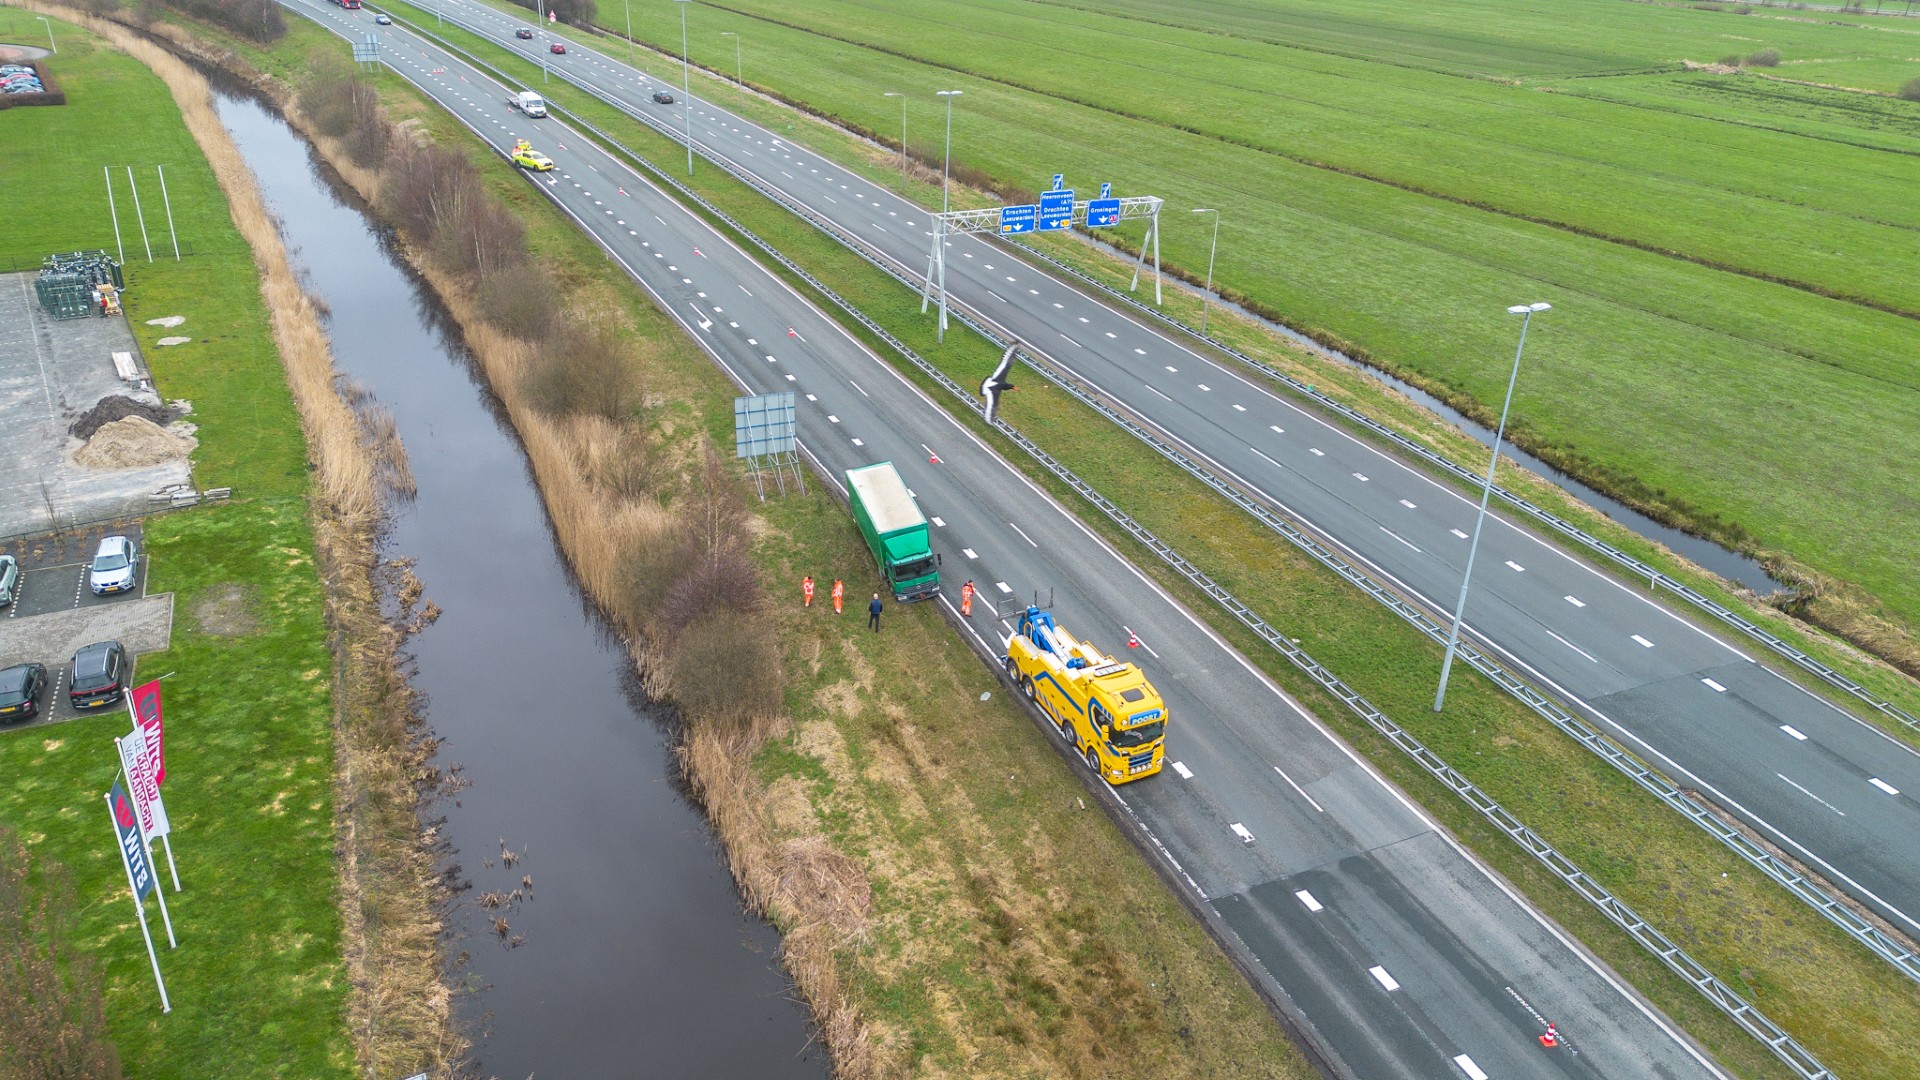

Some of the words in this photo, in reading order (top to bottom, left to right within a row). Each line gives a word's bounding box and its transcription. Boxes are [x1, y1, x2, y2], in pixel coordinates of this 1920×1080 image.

[124, 743, 136, 769] VAN
[134, 737, 145, 754] DE
[144, 720, 161, 778] WITS
[136, 753, 158, 800] KRACHT
[124, 826, 149, 890] WITS
